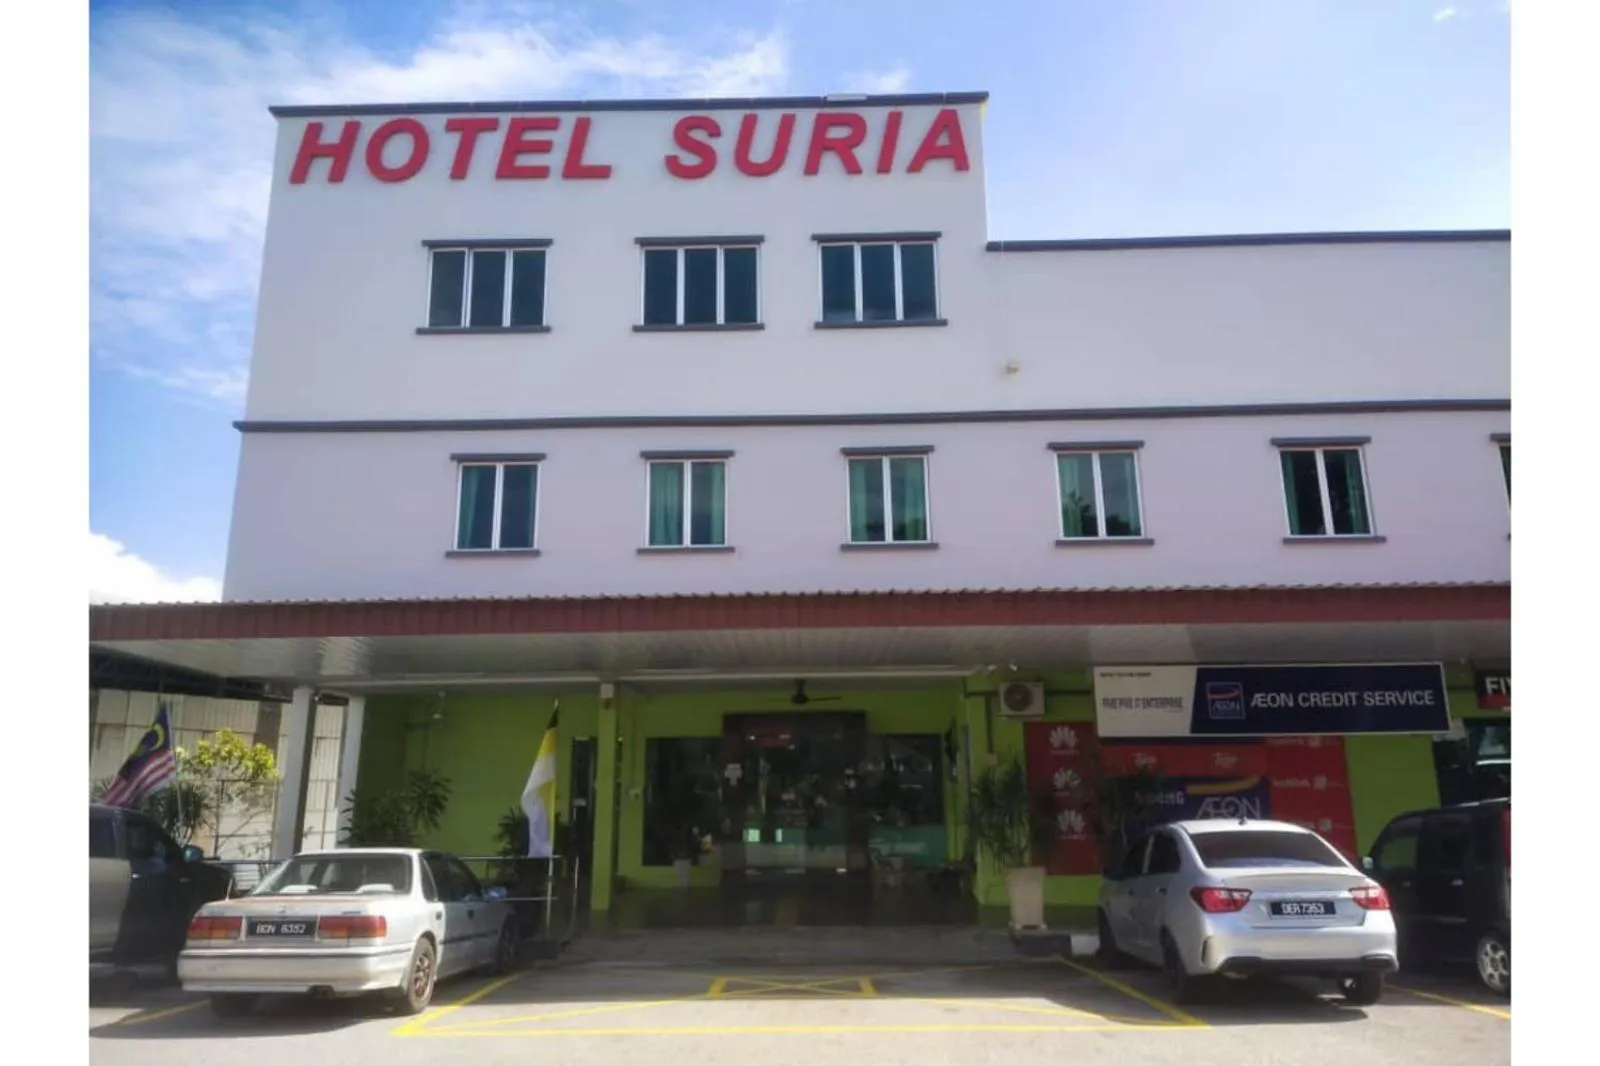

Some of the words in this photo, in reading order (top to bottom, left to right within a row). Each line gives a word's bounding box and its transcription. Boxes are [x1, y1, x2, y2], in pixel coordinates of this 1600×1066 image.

[289, 117, 613, 185] HOTEL
[664, 109, 970, 179] SURIA
[1298, 691, 1359, 707] CREDIT
[1363, 690, 1435, 706] SERVICE
